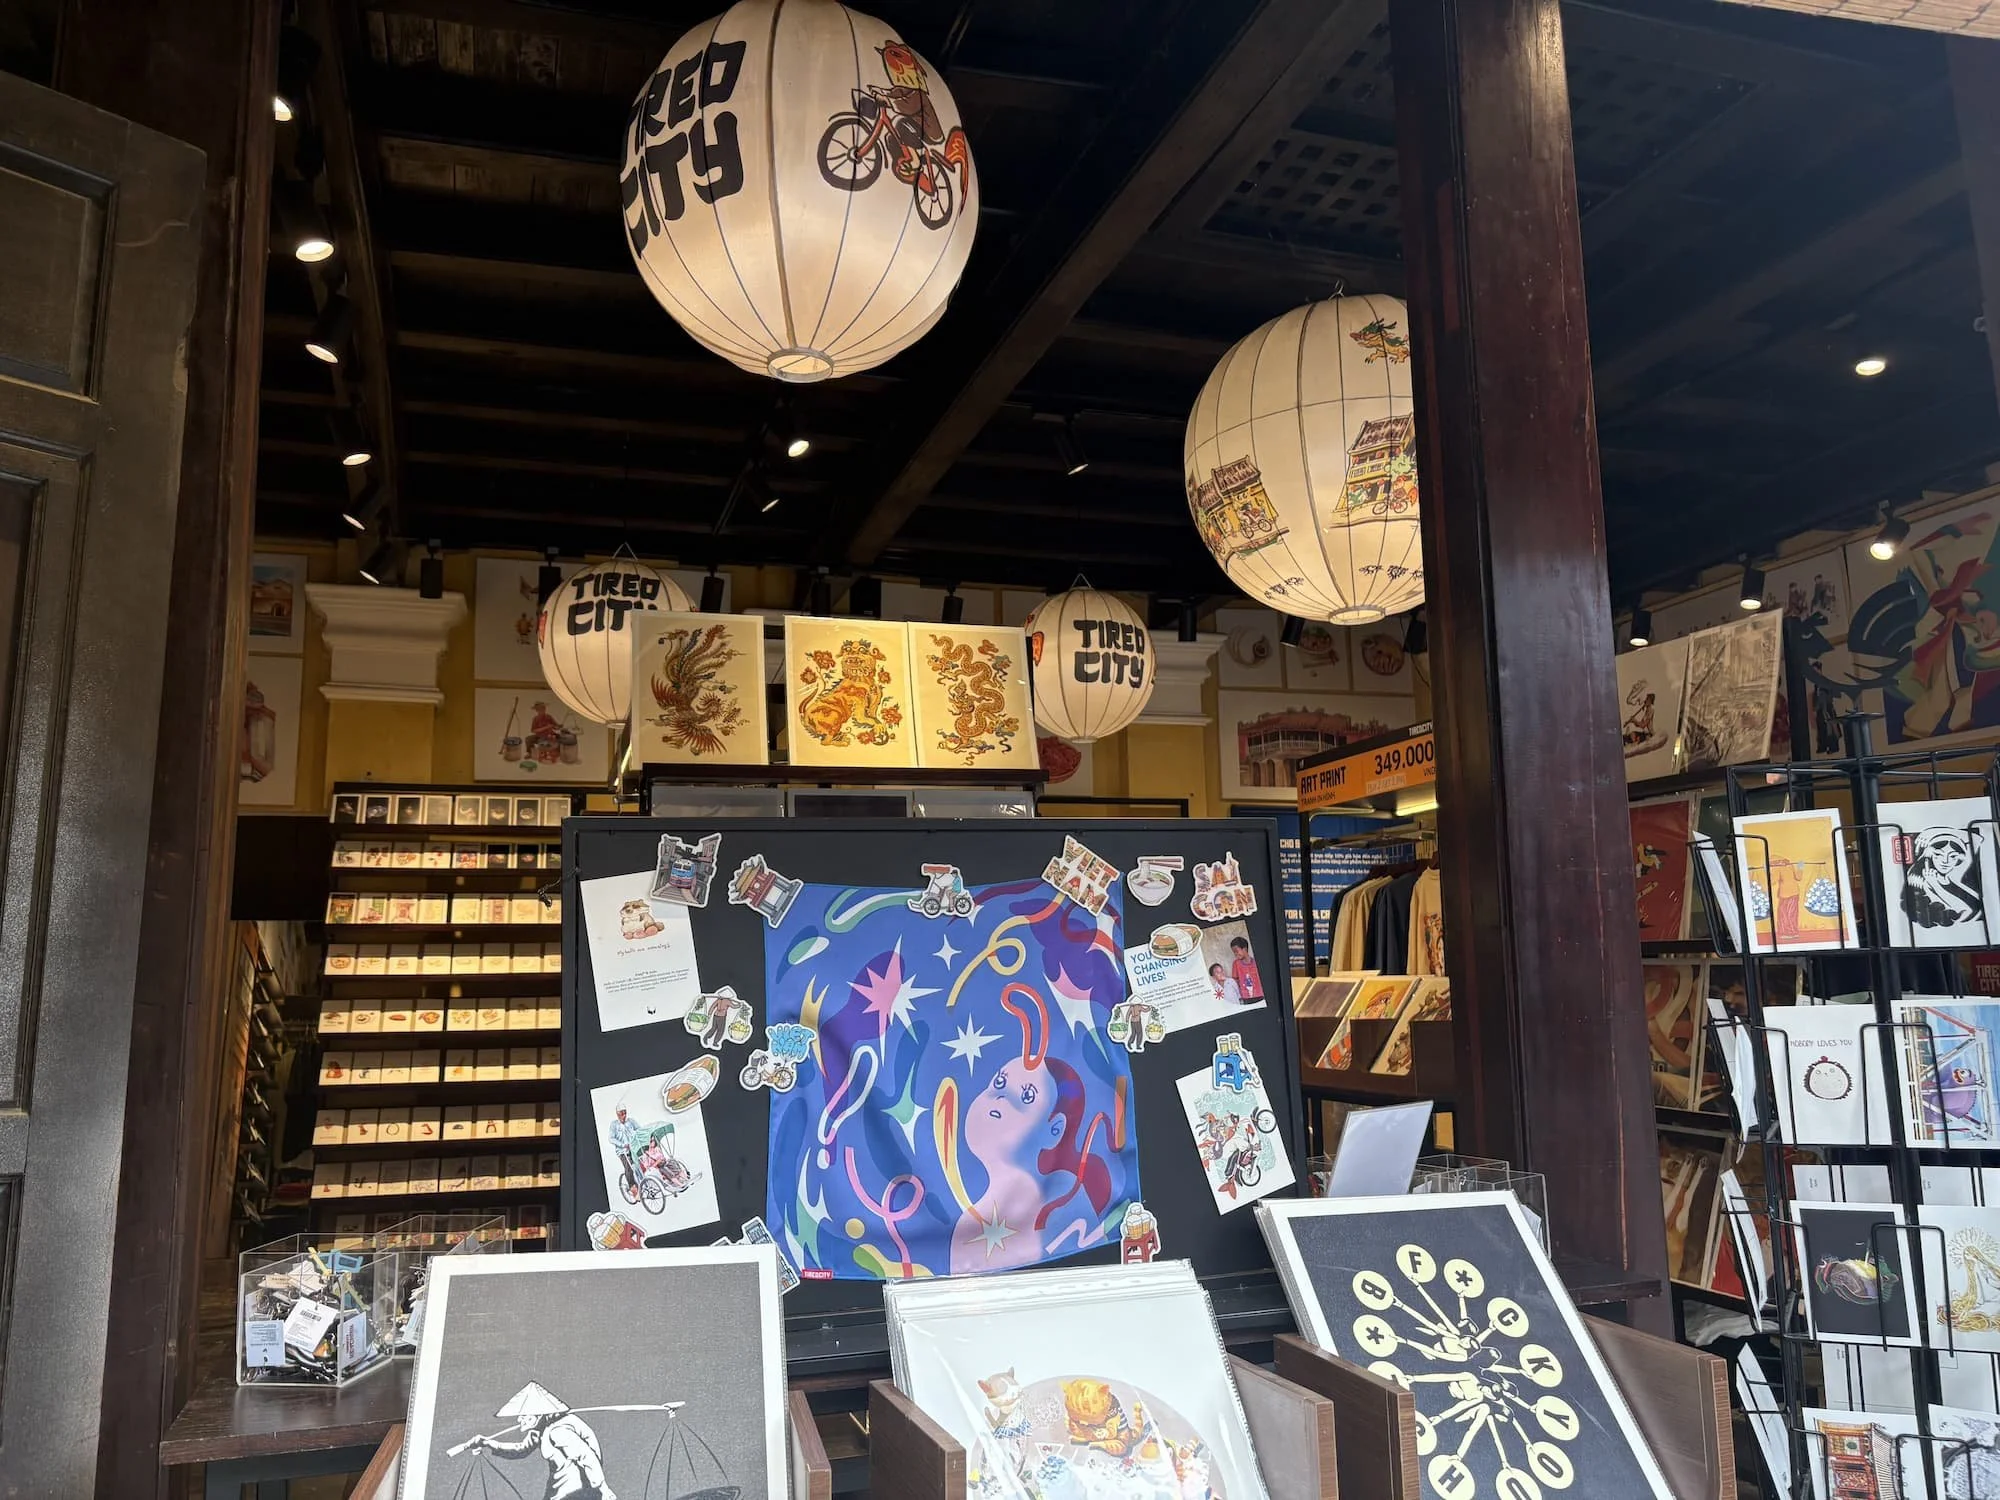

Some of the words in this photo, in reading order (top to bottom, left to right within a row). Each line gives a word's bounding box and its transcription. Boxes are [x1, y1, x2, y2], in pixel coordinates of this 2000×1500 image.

[620, 111, 743, 259] CITY
[571, 572, 660, 600] TIRED
[568, 598, 658, 636] CIT
[1073, 620, 1145, 655] TIRED
[1074, 651, 1144, 688] CITY
[1374, 741, 1434, 775] 349.000
[1301, 774, 1317, 795] ART
[1320, 766, 1346, 790] PRINT
[1134, 956, 1187, 974] CHANGING
[1137, 971, 1167, 986] LIVES!
[1976, 965, 2000, 978] TIRE
